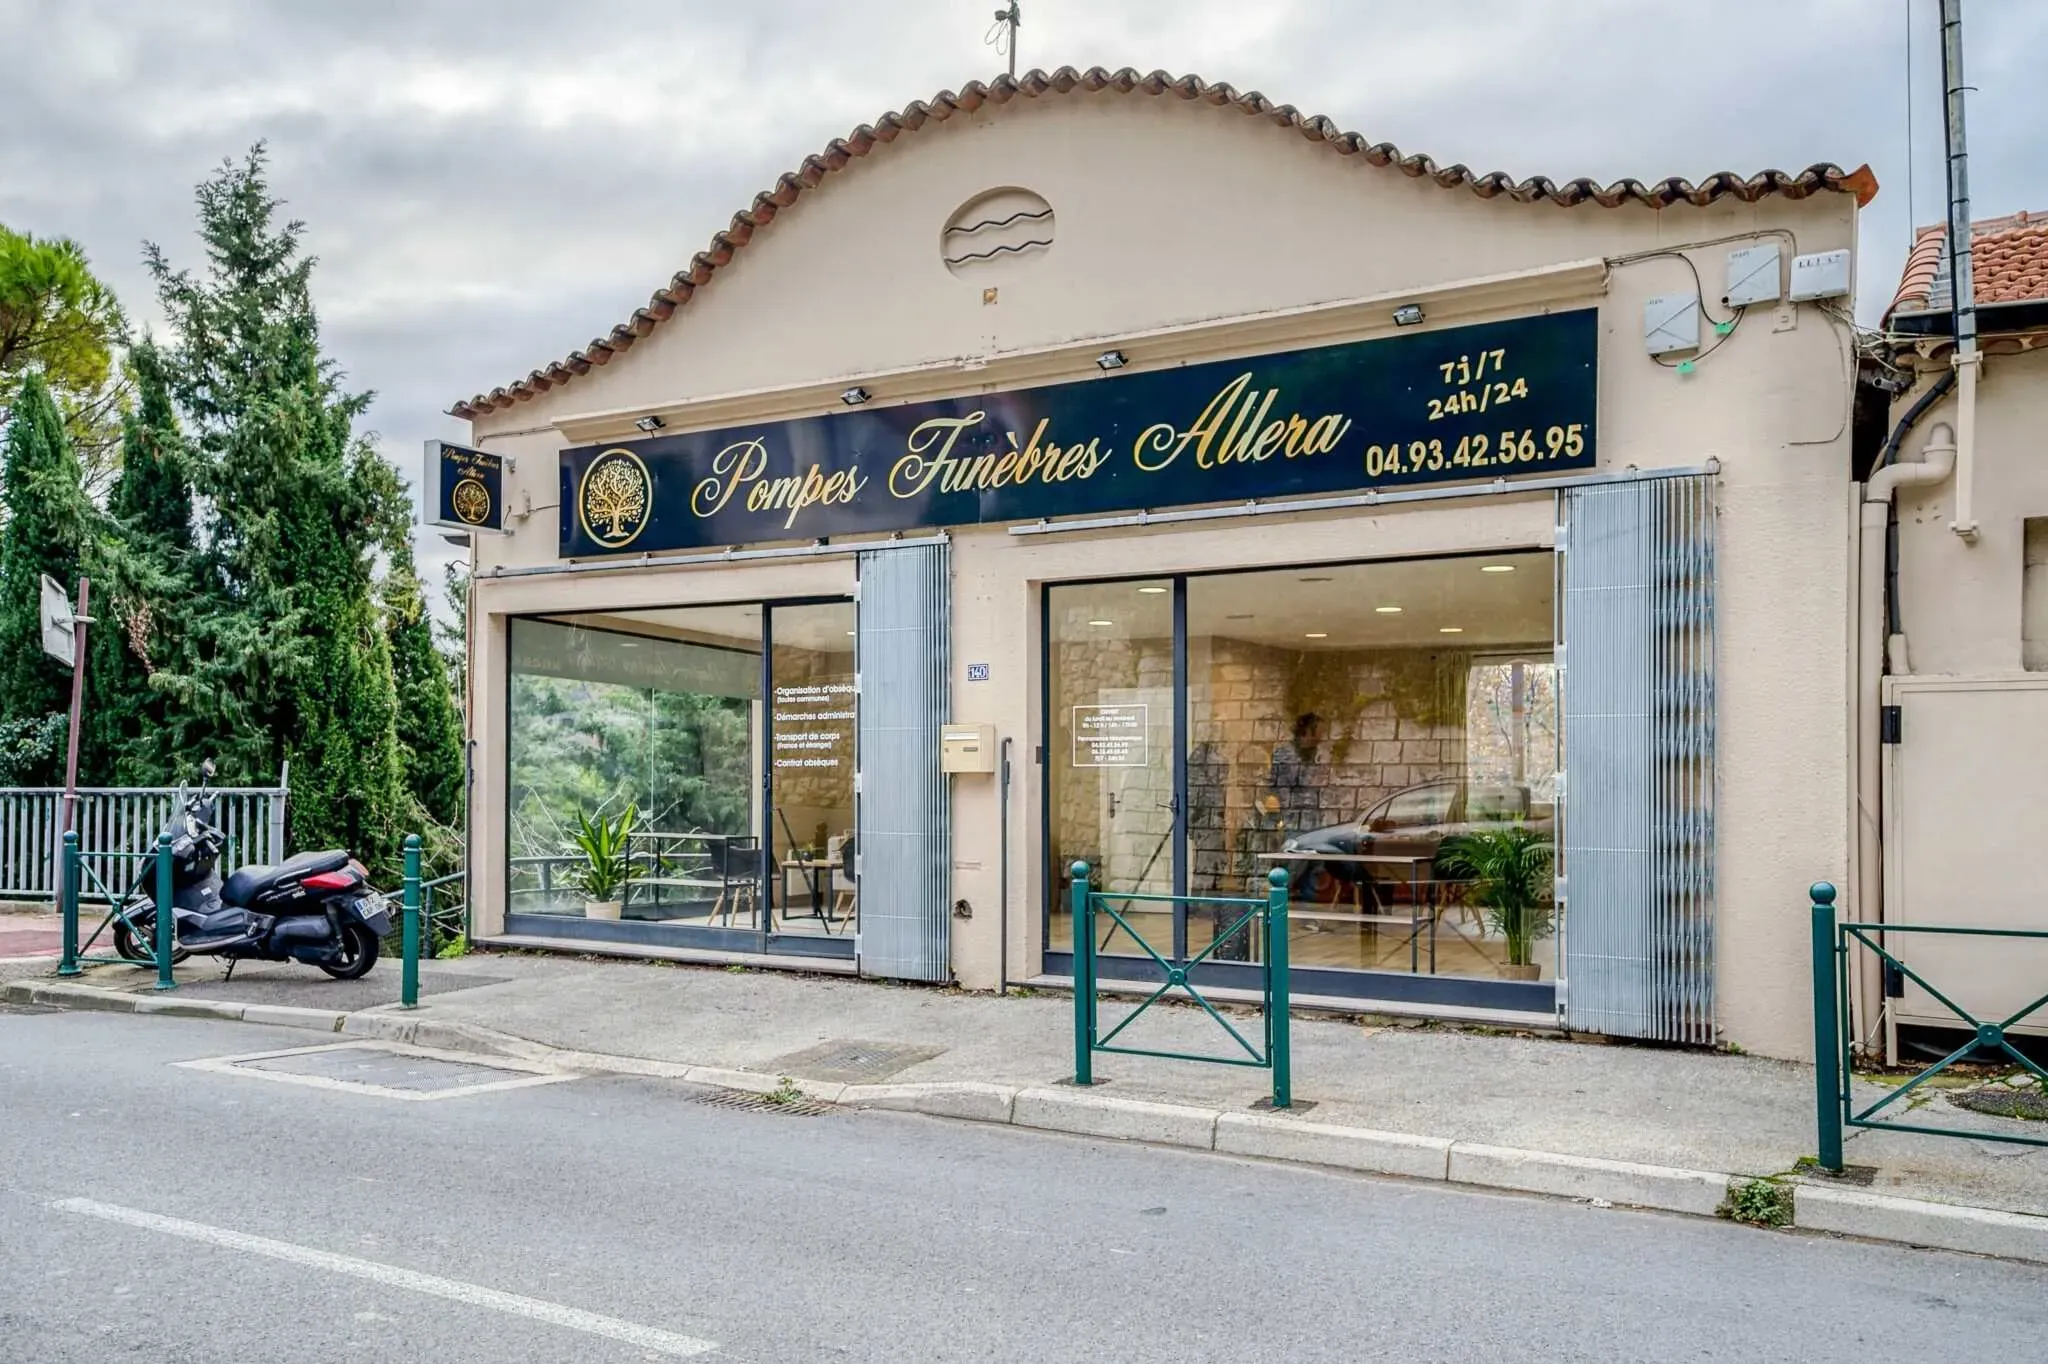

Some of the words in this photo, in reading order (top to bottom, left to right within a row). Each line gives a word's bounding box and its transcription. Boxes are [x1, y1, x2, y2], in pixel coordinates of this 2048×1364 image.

[1439, 348, 1507, 386] 7j/7
[1427, 377, 1529, 421] 24h/24
[691, 436, 869, 530] Pompes
[888, 410, 1113, 498] Funèbres
[1133, 371, 1352, 472] Allera
[1365, 422, 1585, 478] 04.93.42.56.95
[970, 666, 986, 678] 140
[817, 711, 856, 720] administra
